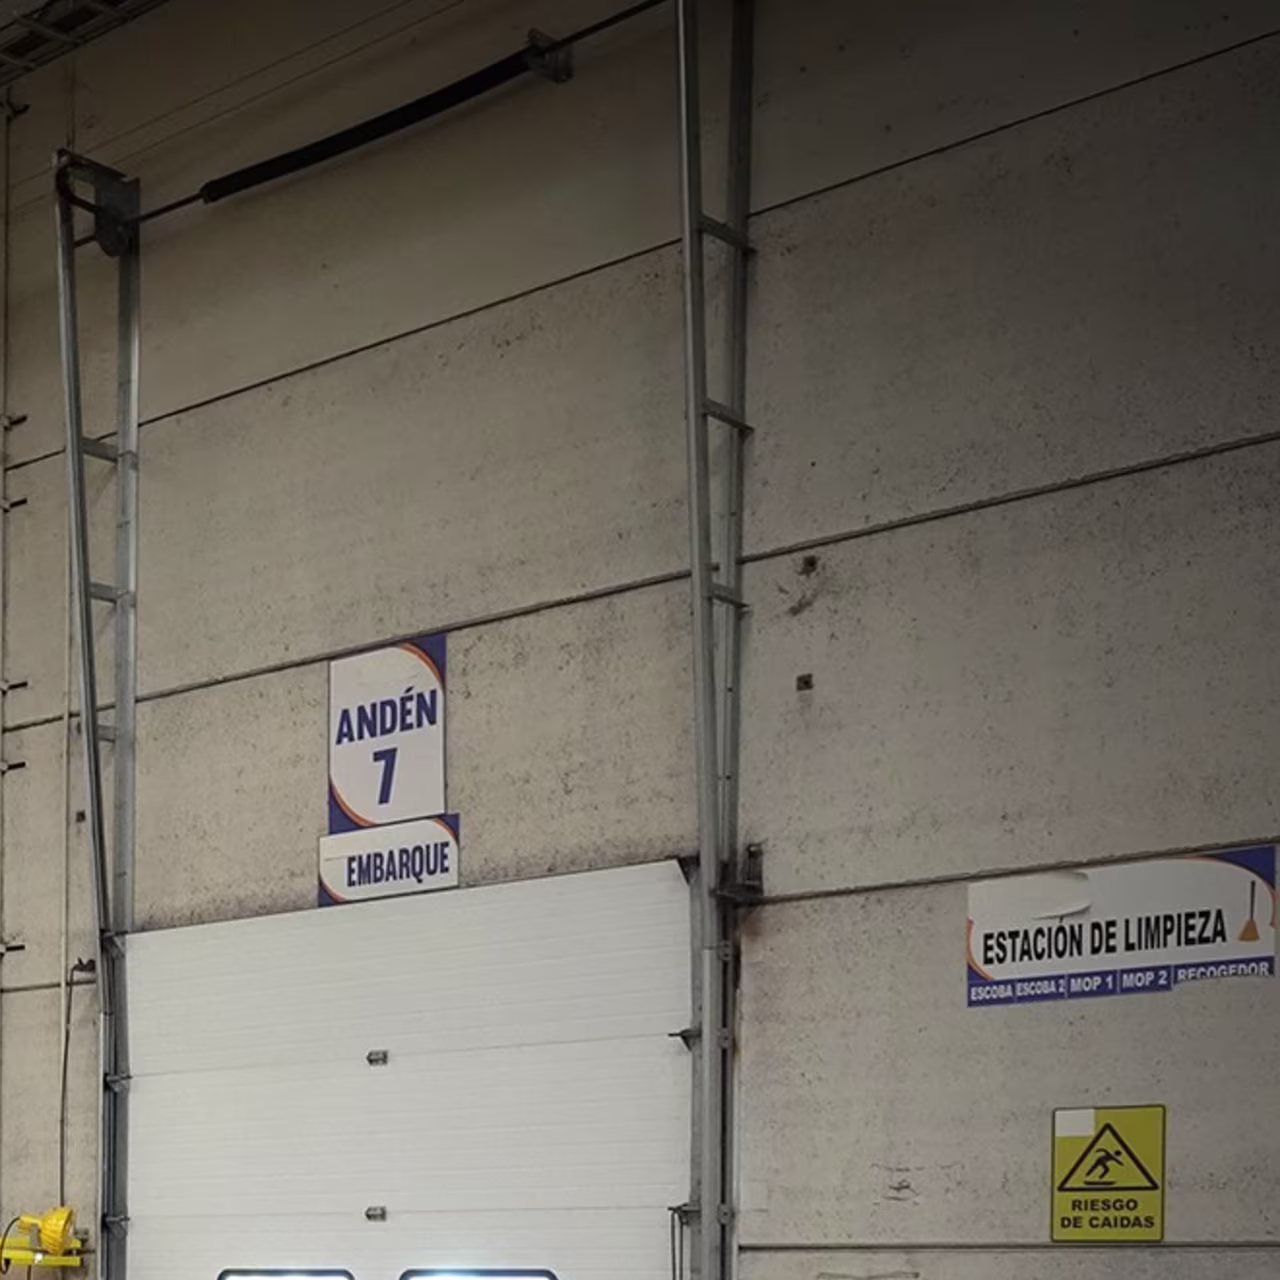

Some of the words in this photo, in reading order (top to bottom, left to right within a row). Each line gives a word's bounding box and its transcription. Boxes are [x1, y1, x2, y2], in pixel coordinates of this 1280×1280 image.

[336, 686, 437, 745] ANDÉN
[373, 748, 398, 805] 7
[347, 841, 450, 887] EMBARQUE
[983, 916, 1083, 965] ESTACIÓN
[1090, 920, 1117, 955] DE
[1124, 909, 1227, 952] LIMPIEZA
[970, 984, 1013, 1000] ESCOBA
[1015, 980, 1056, 996] ESCOBA
[1058, 979, 1065, 992] 2
[1070, 977, 1100, 992] MOP
[1106, 976, 1113, 990] 1
[1122, 973, 1153, 988] MOP
[1158, 971, 1167, 985] 2
[1060, 1216, 1083, 1228] DE
[1089, 1216, 1155, 1228] CAIDAS
[1071, 1198, 1138, 1211] RIESGO
